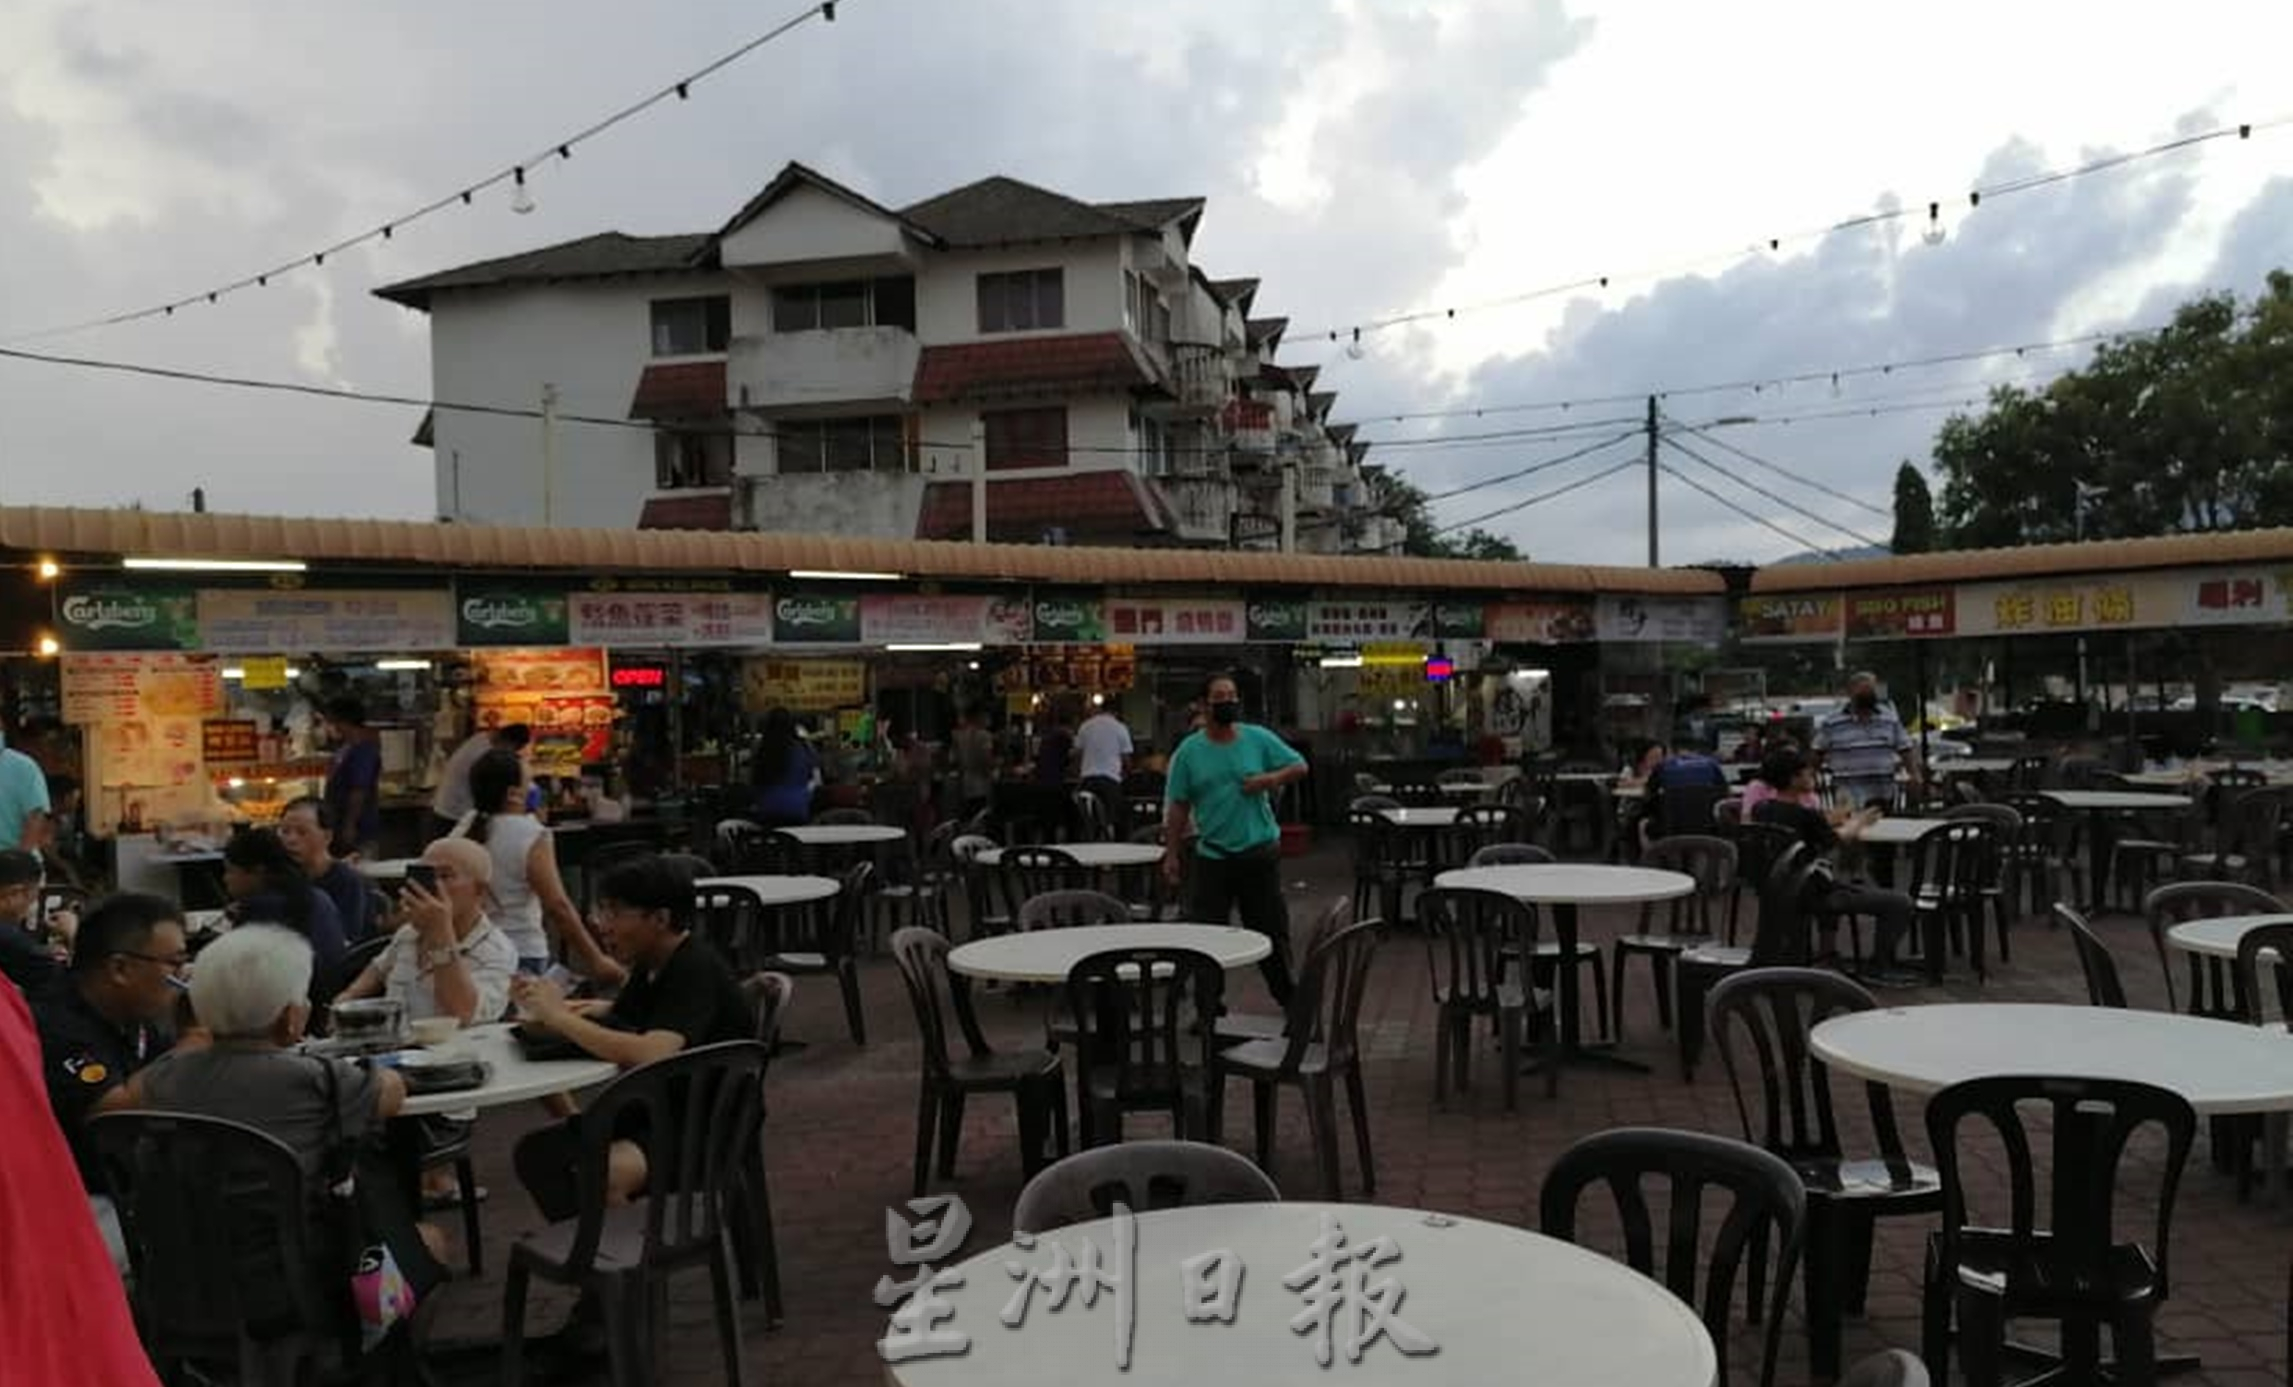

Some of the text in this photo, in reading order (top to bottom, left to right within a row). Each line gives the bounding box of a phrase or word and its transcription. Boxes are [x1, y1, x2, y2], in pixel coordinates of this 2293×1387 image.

[62, 596, 157, 630] Carlsberg
[463, 598, 536, 628] Carlsberg
[776, 599, 835, 625] Carlsberg
[1761, 600, 1830, 619] SATAY
[613, 669, 663, 686] OPEN
